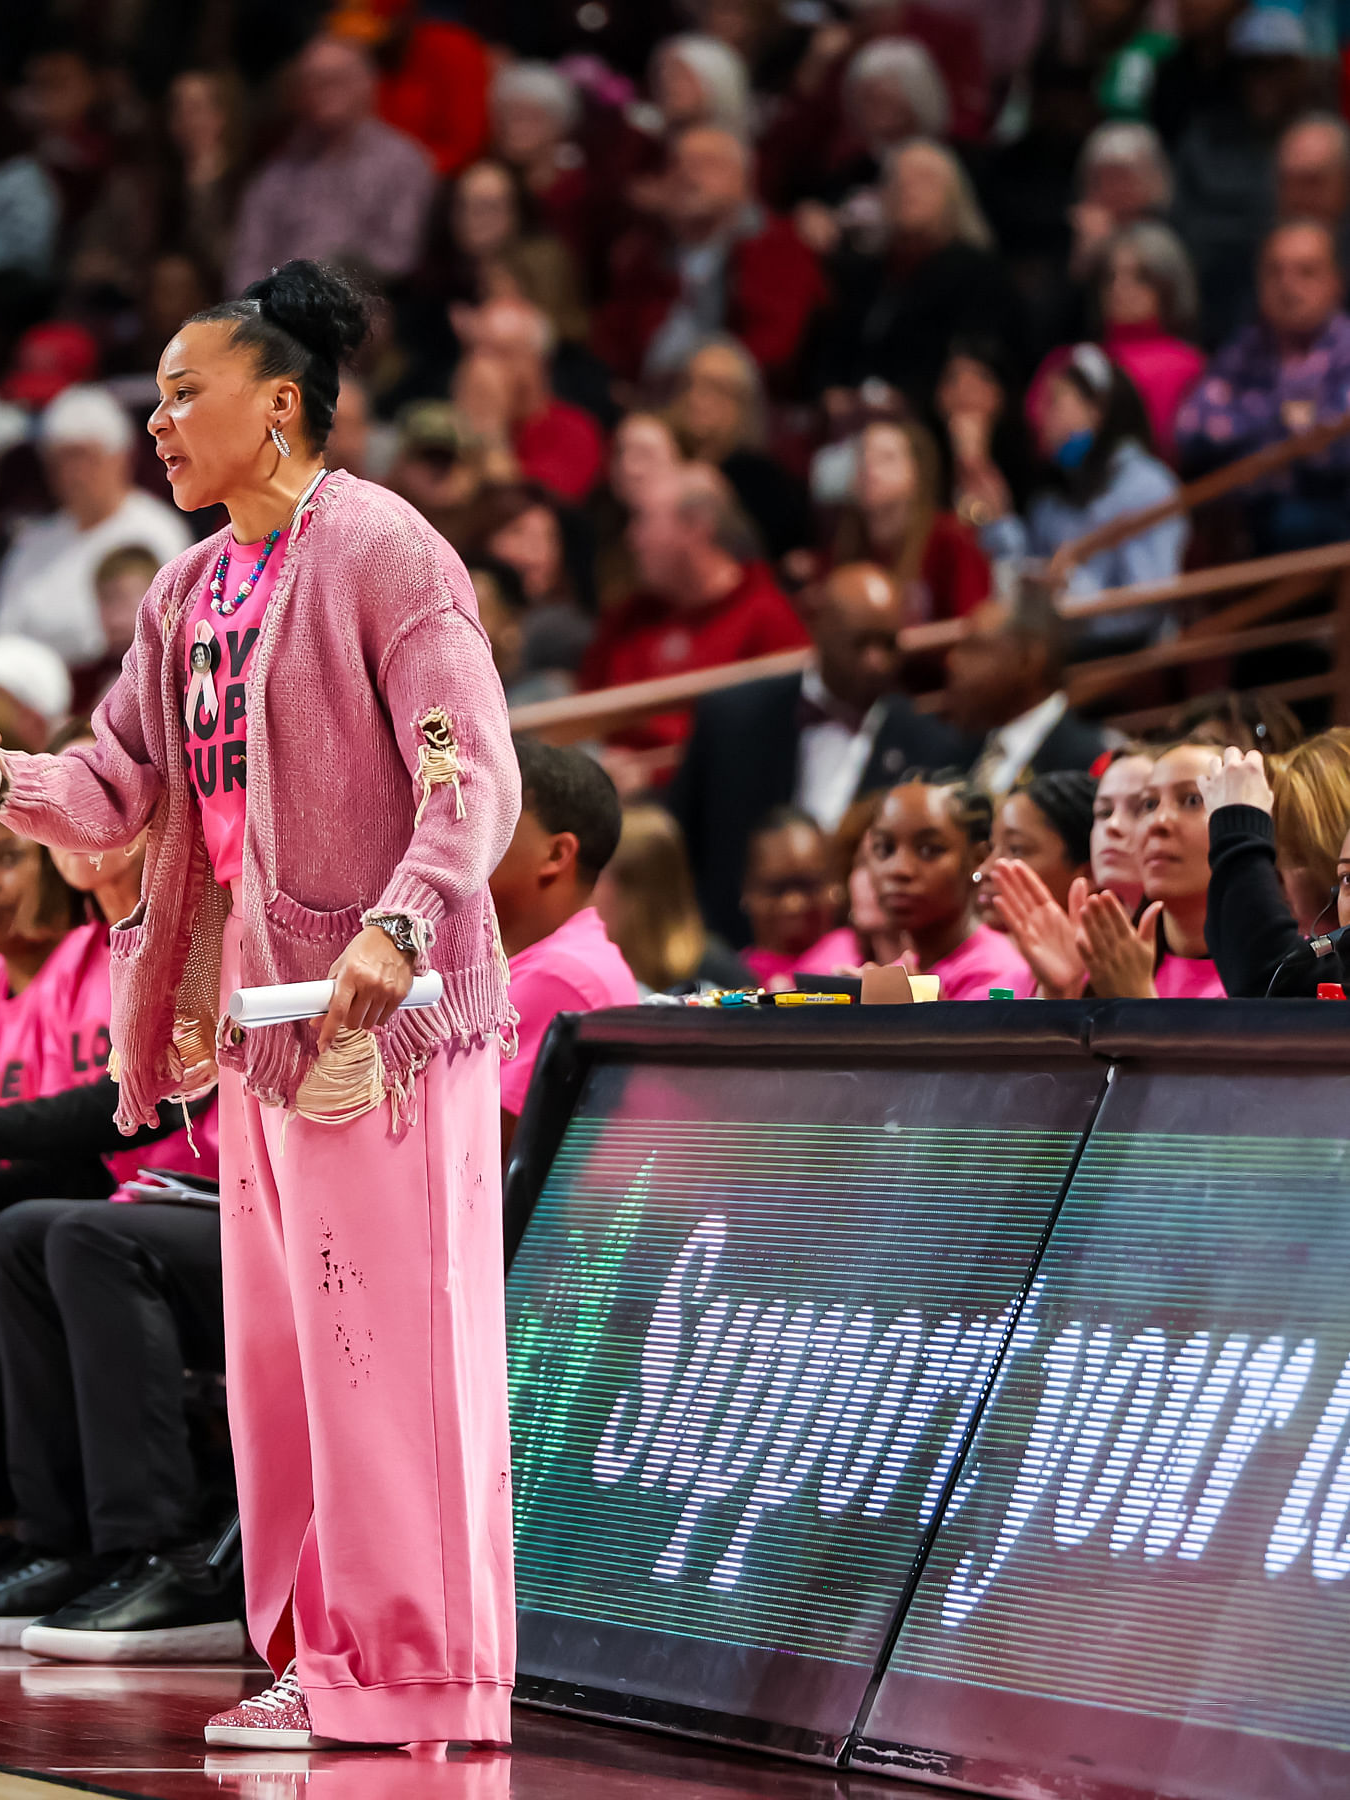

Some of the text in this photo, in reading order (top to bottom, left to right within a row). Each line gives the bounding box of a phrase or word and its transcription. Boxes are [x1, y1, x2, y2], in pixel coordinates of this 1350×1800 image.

[186, 740, 247, 797] UR
[592, 1213, 1048, 1593] Support
[942, 1320, 1315, 1627] your
